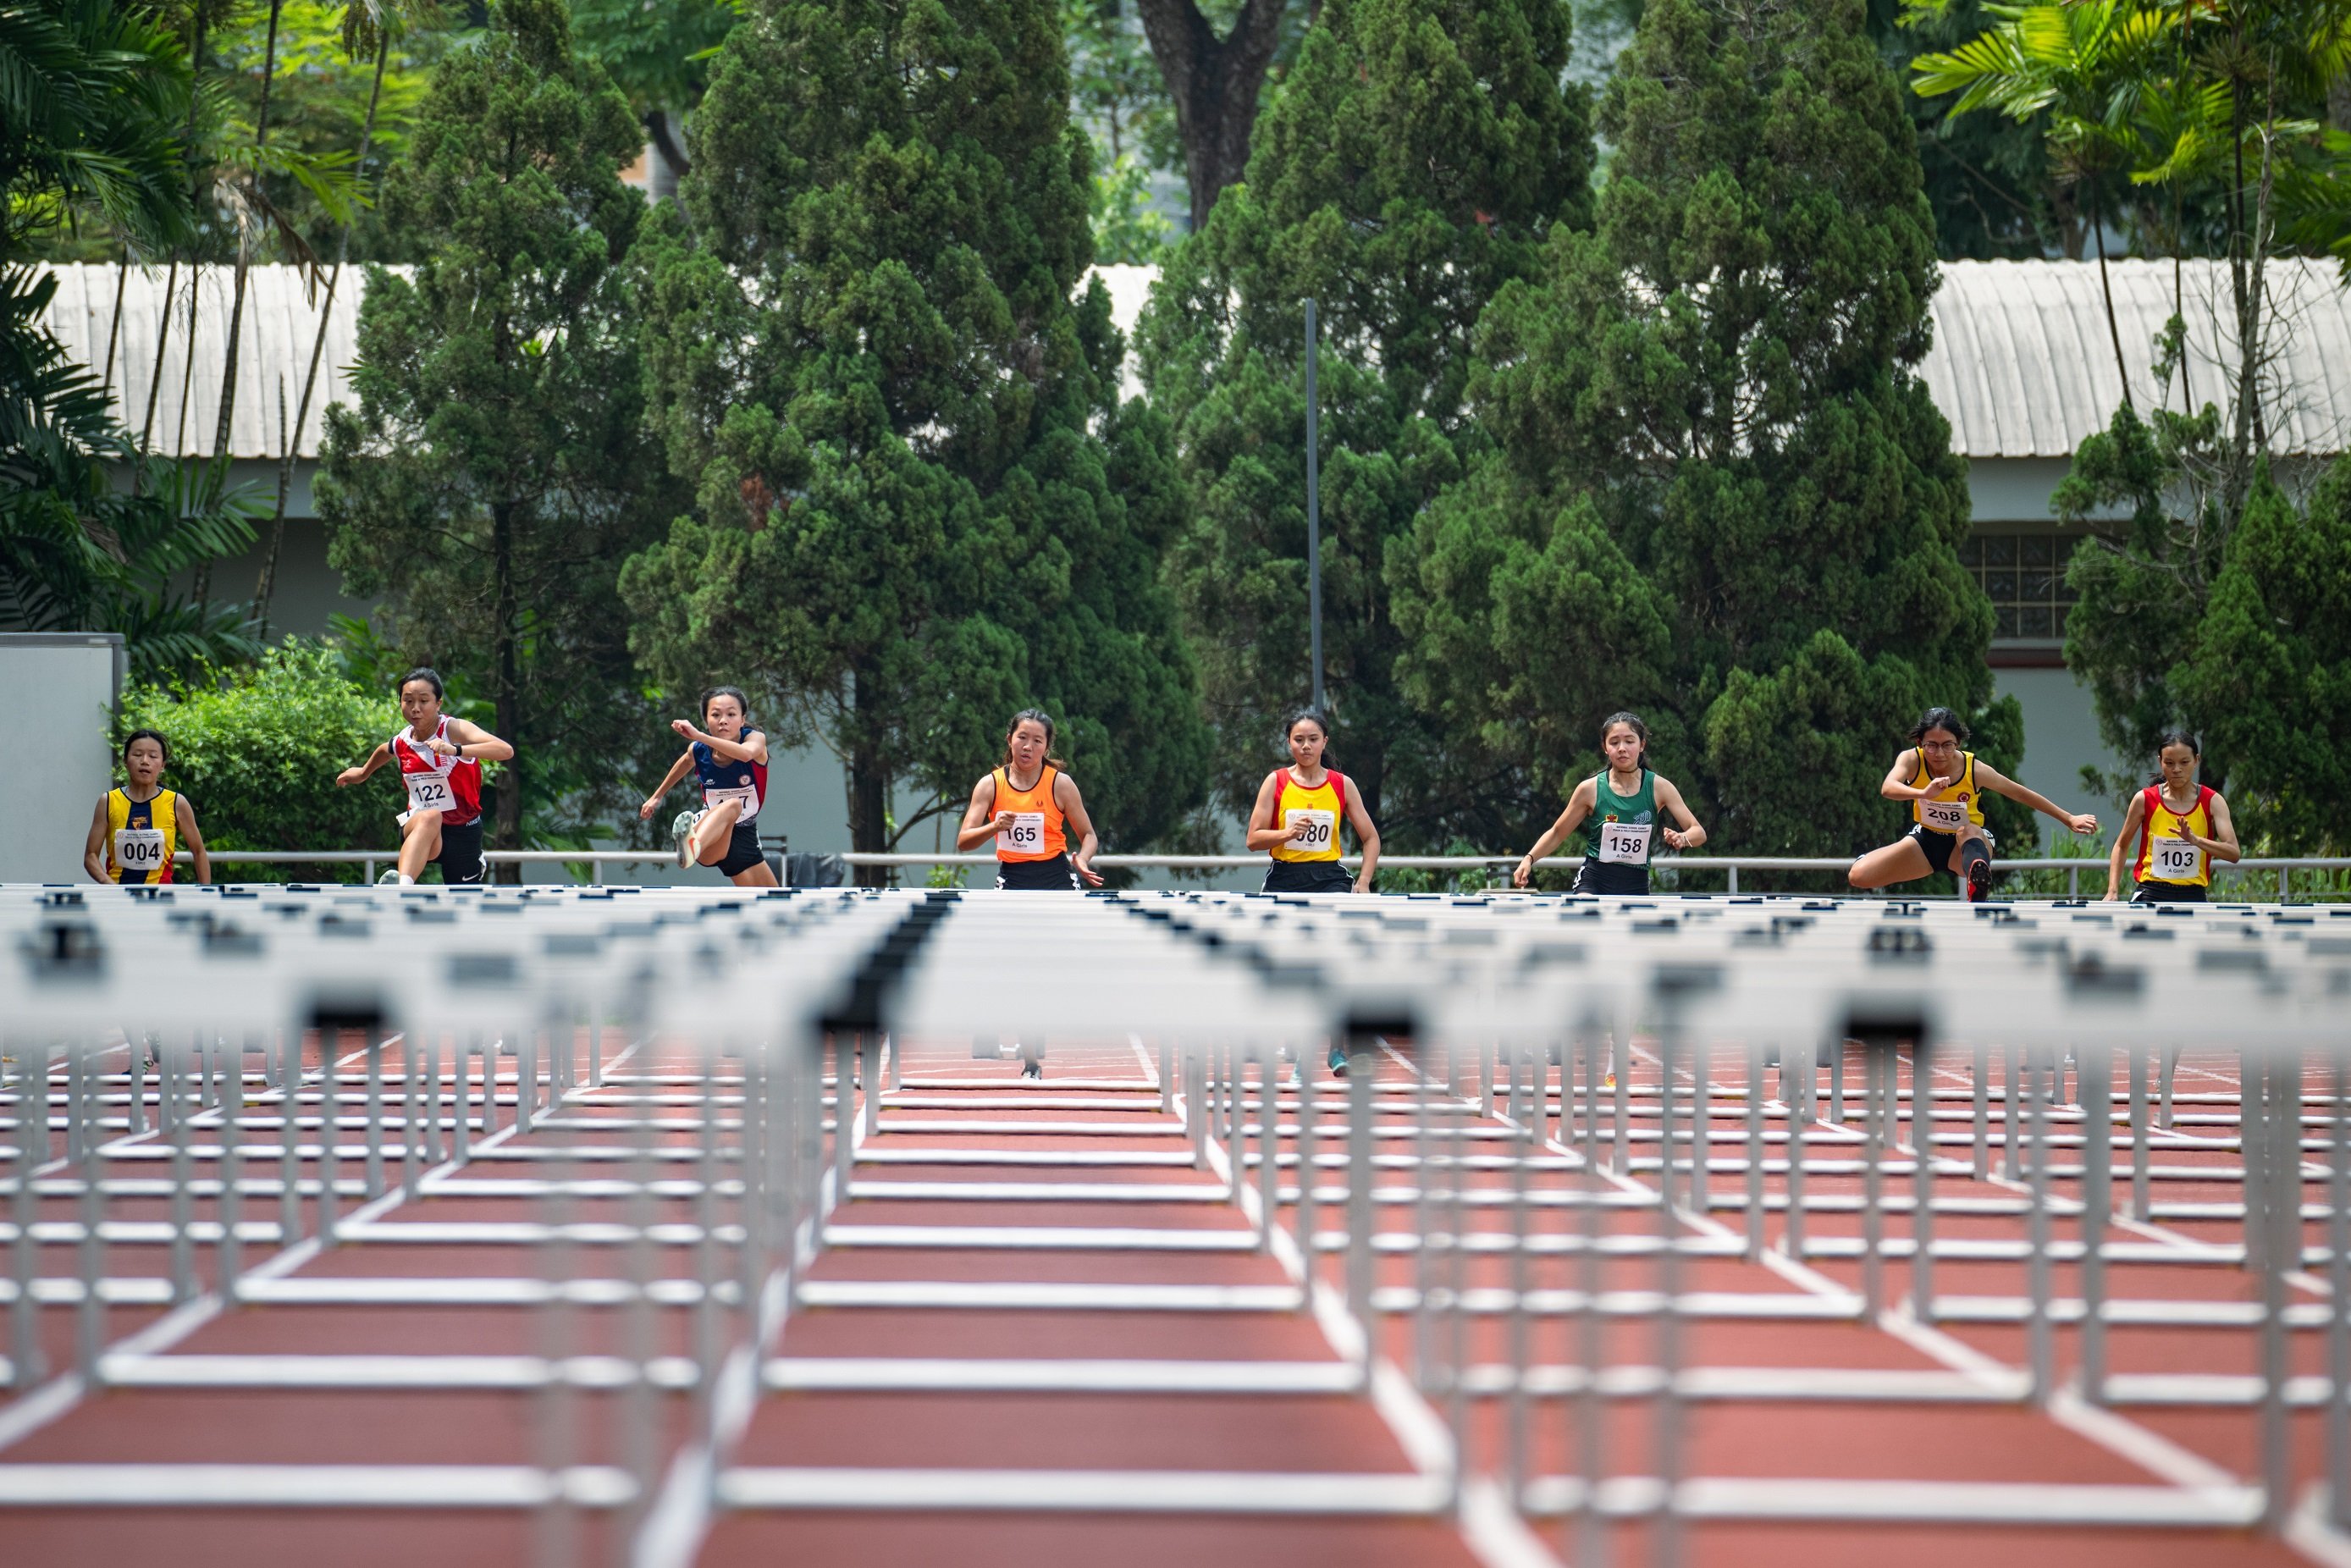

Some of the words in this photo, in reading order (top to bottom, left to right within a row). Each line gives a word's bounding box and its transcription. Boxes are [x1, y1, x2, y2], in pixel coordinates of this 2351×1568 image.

[415, 784, 446, 801] 122
[1928, 808, 1961, 822] 208
[1005, 827, 1036, 842] 165
[124, 842, 160, 861] 004
[1610, 837, 1642, 853] 158
[2161, 851, 2194, 867] 103
